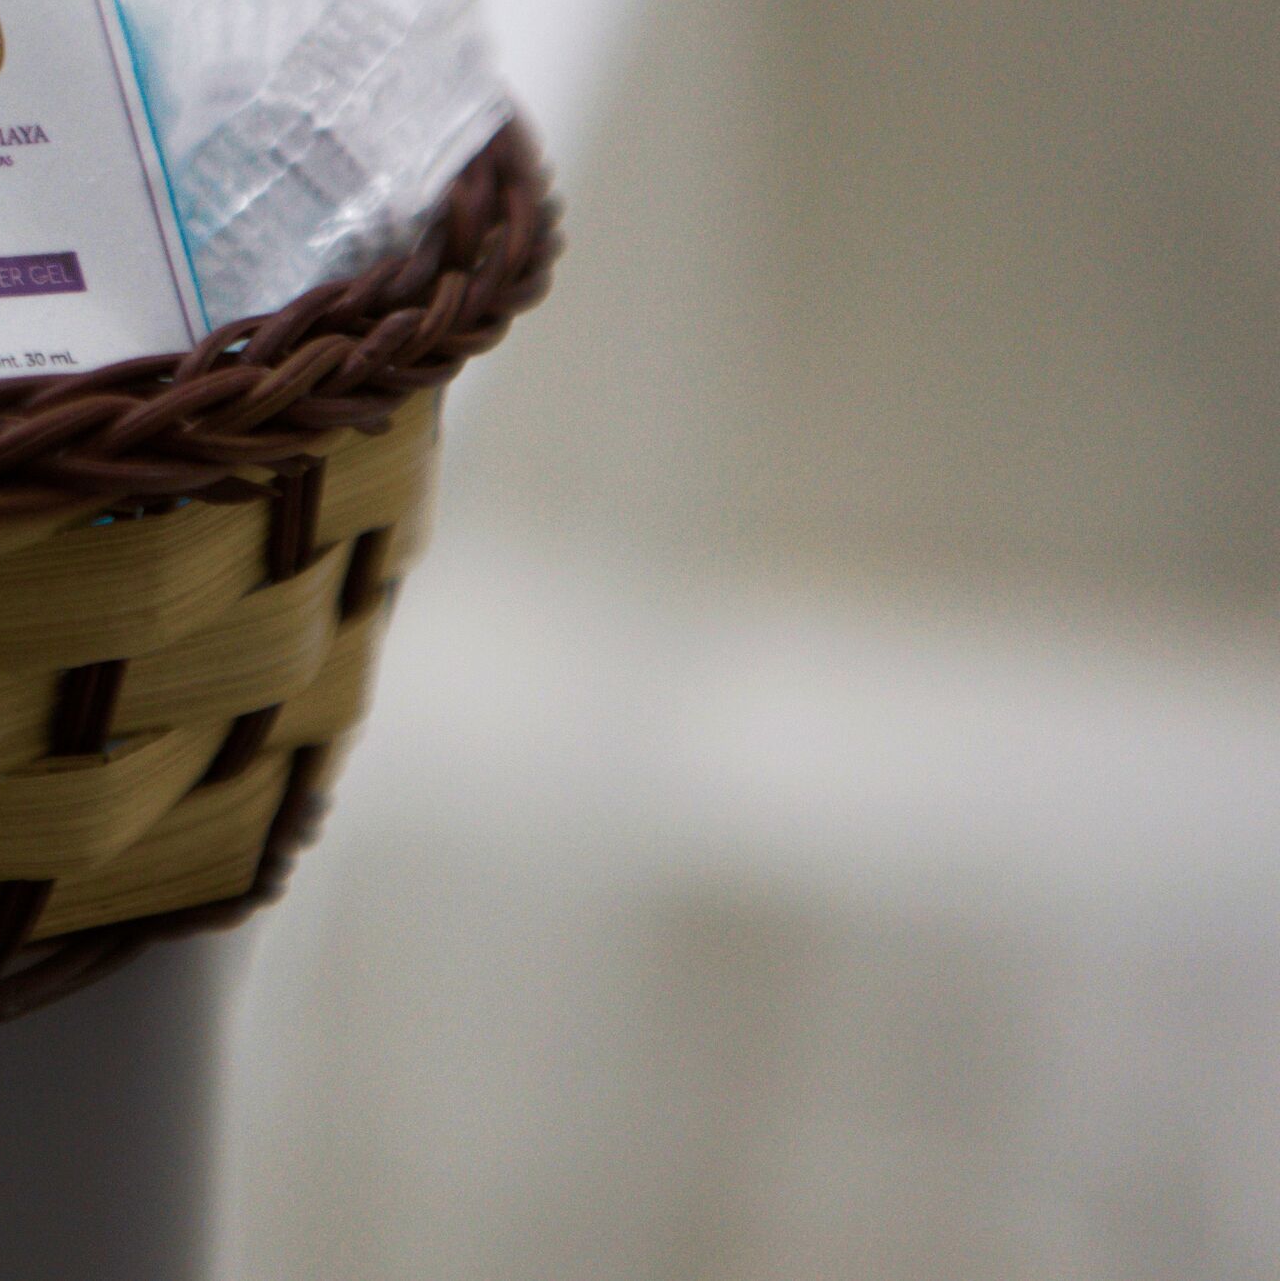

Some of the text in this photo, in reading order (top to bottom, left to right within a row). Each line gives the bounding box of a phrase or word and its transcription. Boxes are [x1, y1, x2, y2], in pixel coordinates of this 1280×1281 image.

[28, 264, 76, 286] GEL
[25, 353, 46, 367] 30
[50, 351, 78, 365] mL
